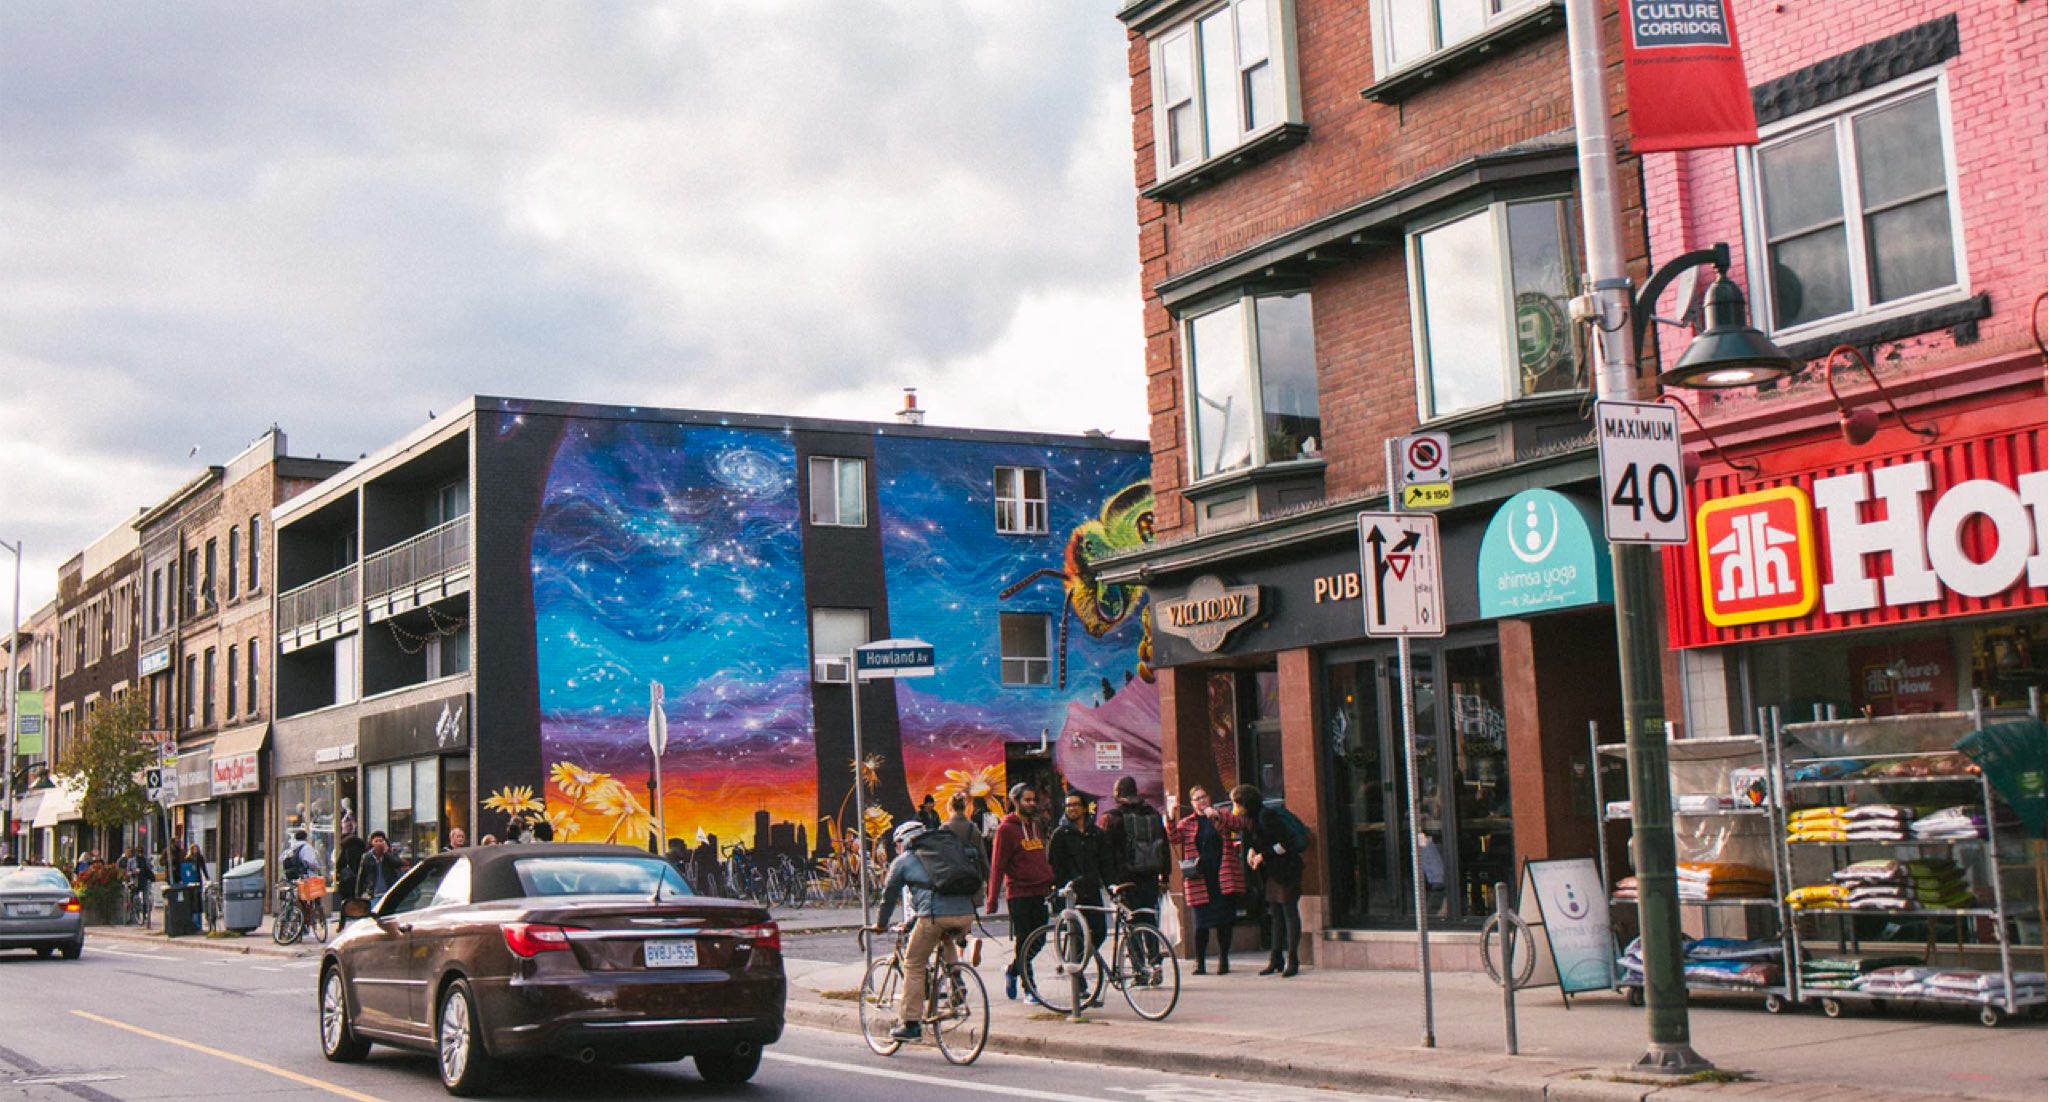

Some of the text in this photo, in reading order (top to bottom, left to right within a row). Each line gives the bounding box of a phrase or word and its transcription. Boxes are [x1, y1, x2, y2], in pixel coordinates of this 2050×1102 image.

[1636, 3, 1719, 20] CULTURE
[1638, 21, 1722, 36] CORRIDOR
[1604, 418, 1674, 441] MAXIMUM
[1612, 462, 1678, 523] 40
[1313, 572, 1360, 604] PUB
[1498, 565, 1577, 591] ahimsa yoga
[1168, 592, 1246, 626] VICTORY
[866, 650, 928, 665] Howland Av
